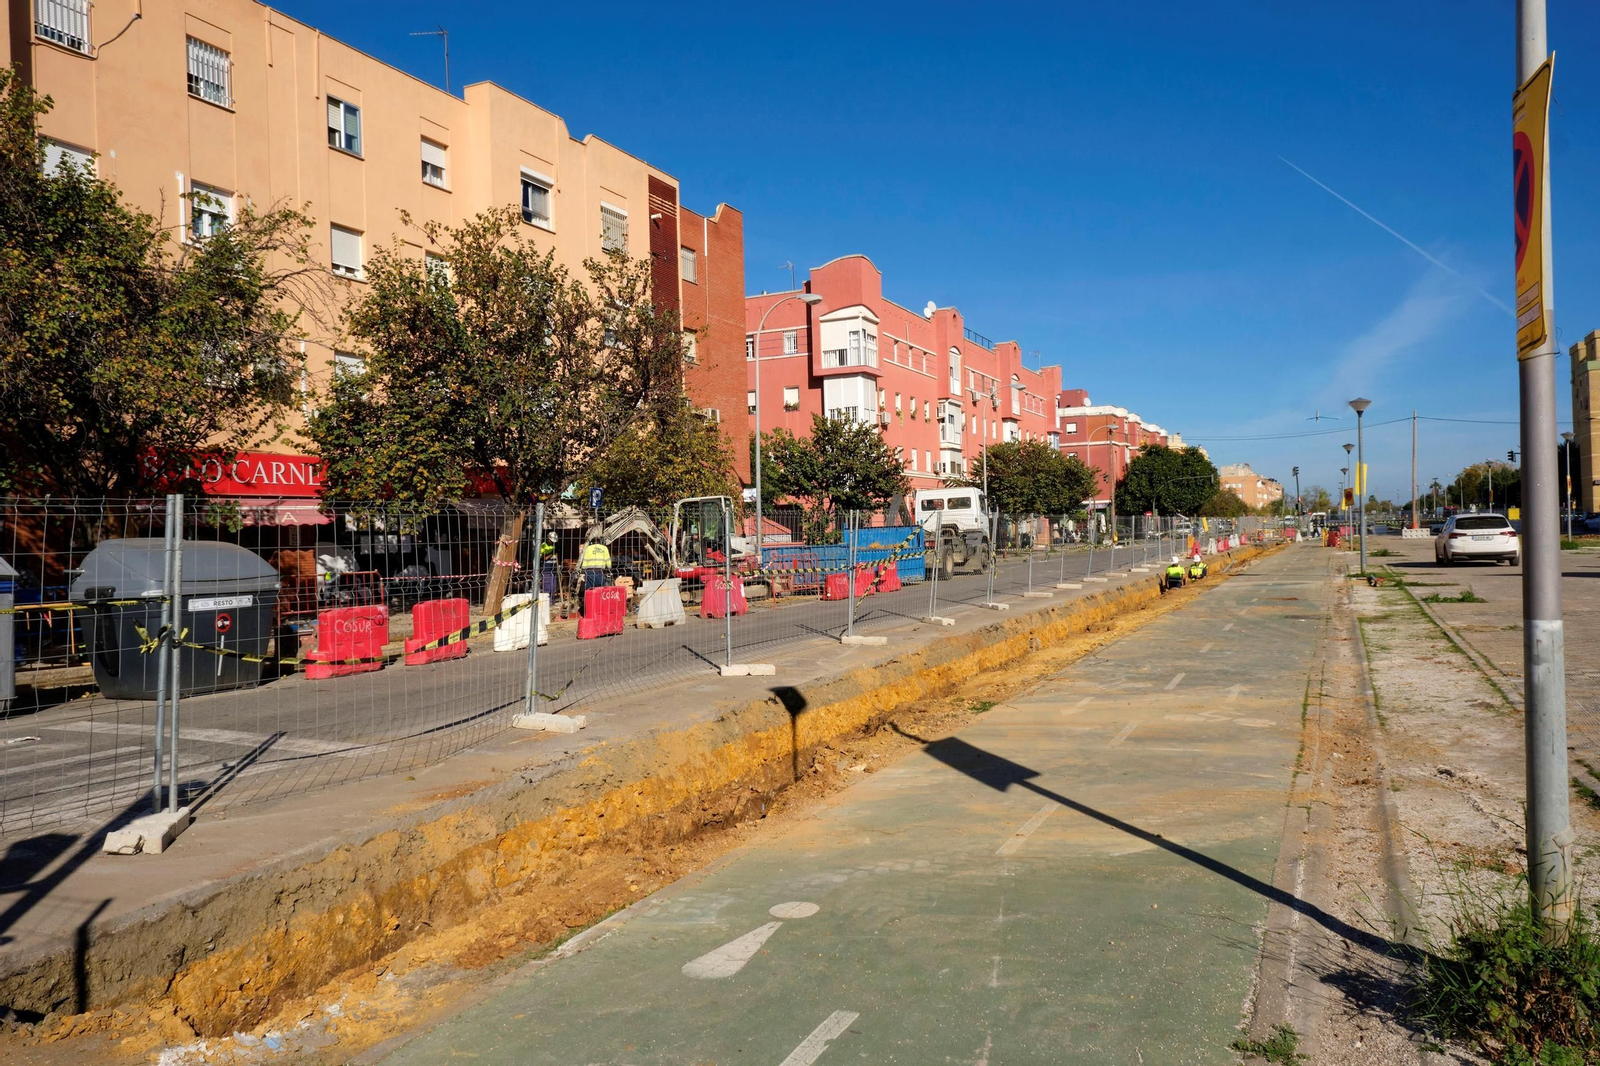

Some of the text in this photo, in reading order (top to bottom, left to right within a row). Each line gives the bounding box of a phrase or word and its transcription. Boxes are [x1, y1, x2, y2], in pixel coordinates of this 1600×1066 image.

[592, 489, 602, 506] P
[213, 599, 233, 607] RESTO
[334, 619, 372, 634] COSUR
